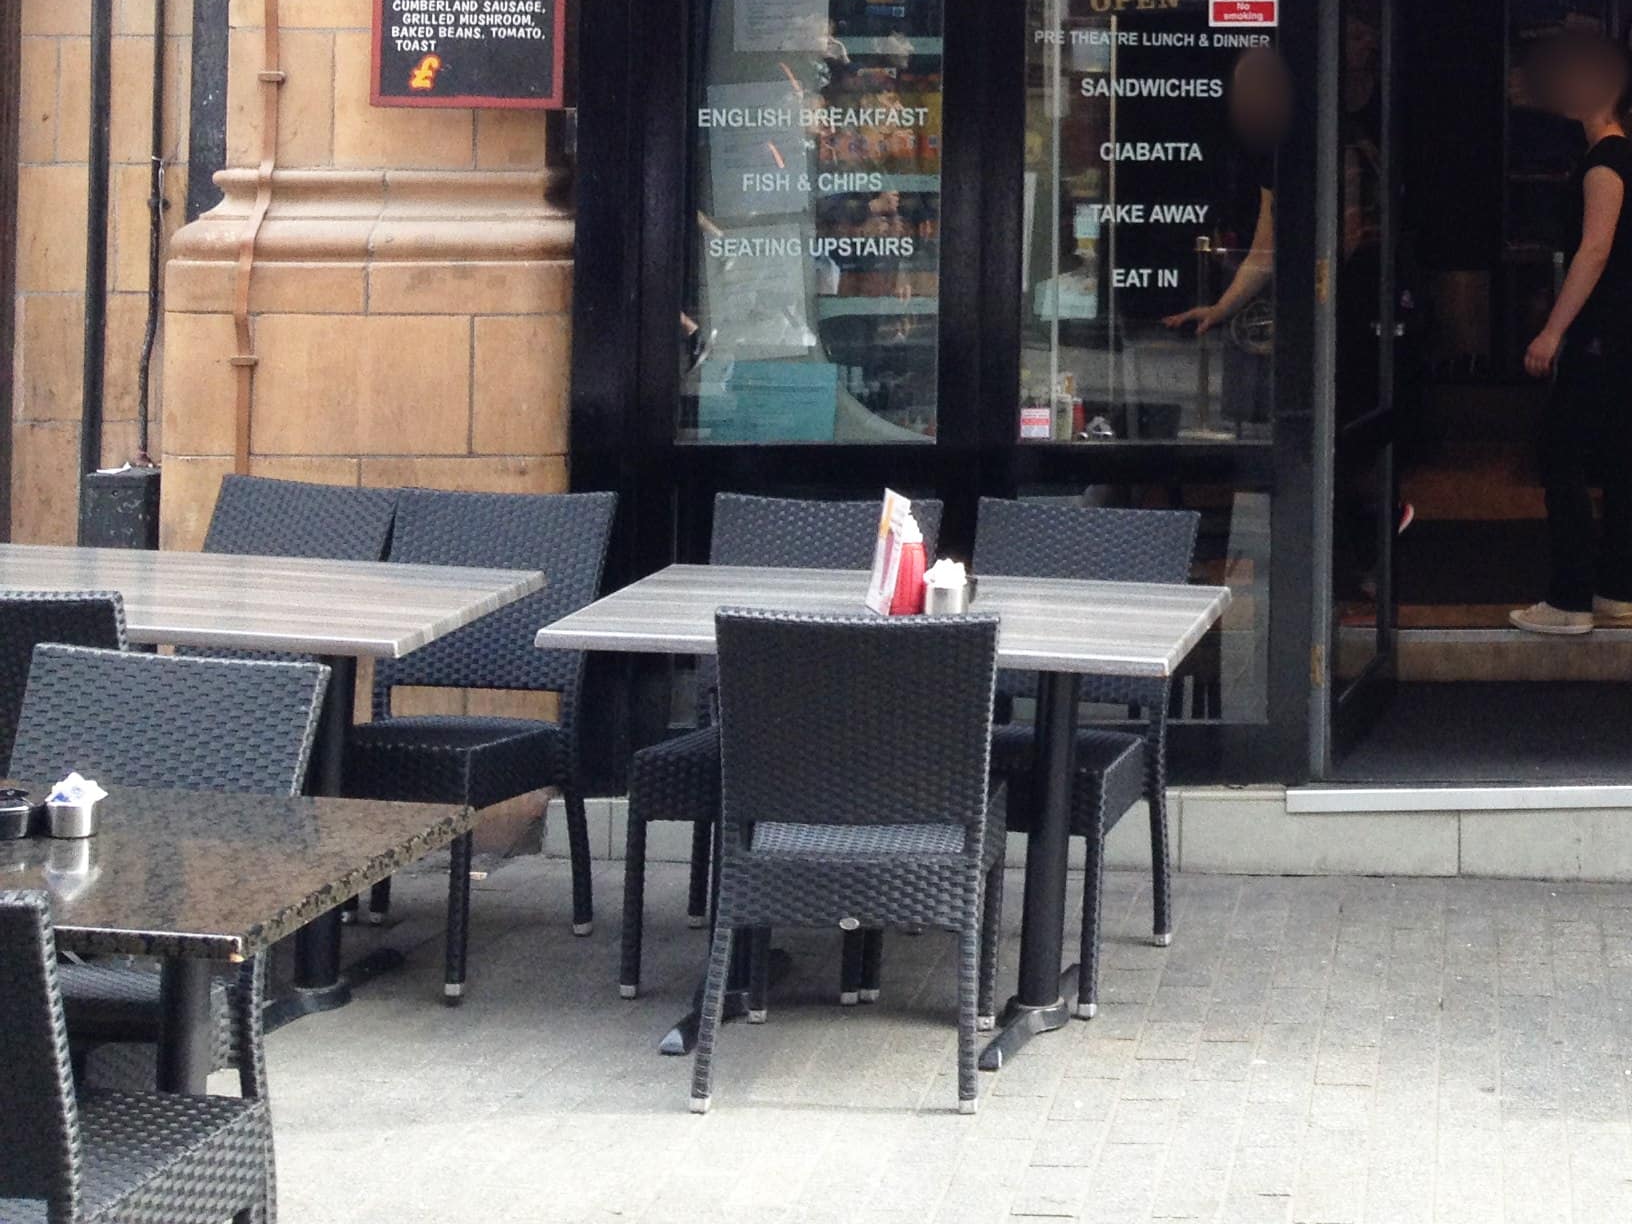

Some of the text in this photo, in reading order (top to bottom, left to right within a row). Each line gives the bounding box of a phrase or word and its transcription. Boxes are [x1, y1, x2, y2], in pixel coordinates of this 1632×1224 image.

[393, 0, 546, 14] CUMBERLAND SAUSAGE,
[1236, 2, 1250, 10] No
[402, 14, 535, 27] GRILLED MUSHROOM,
[1223, 11, 1263, 21] smoking
[391, 27, 433, 38] BAKED
[1034, 31, 1270, 48] PRE THEATRE LUNCH & DINNER
[395, 40, 437, 52] TOAST
[1081, 78, 1223, 98] SANDWICHES
[698, 108, 929, 127] ENGLISH BREAKFAST
[1100, 142, 1203, 161] CIABATTA
[743, 172, 882, 192] FISH & CHIPS
[1091, 204, 1209, 223] TAKE AWAY
[709, 237, 914, 256] SEATING UPSTAIRS
[1112, 269, 1178, 288] EAT IN
